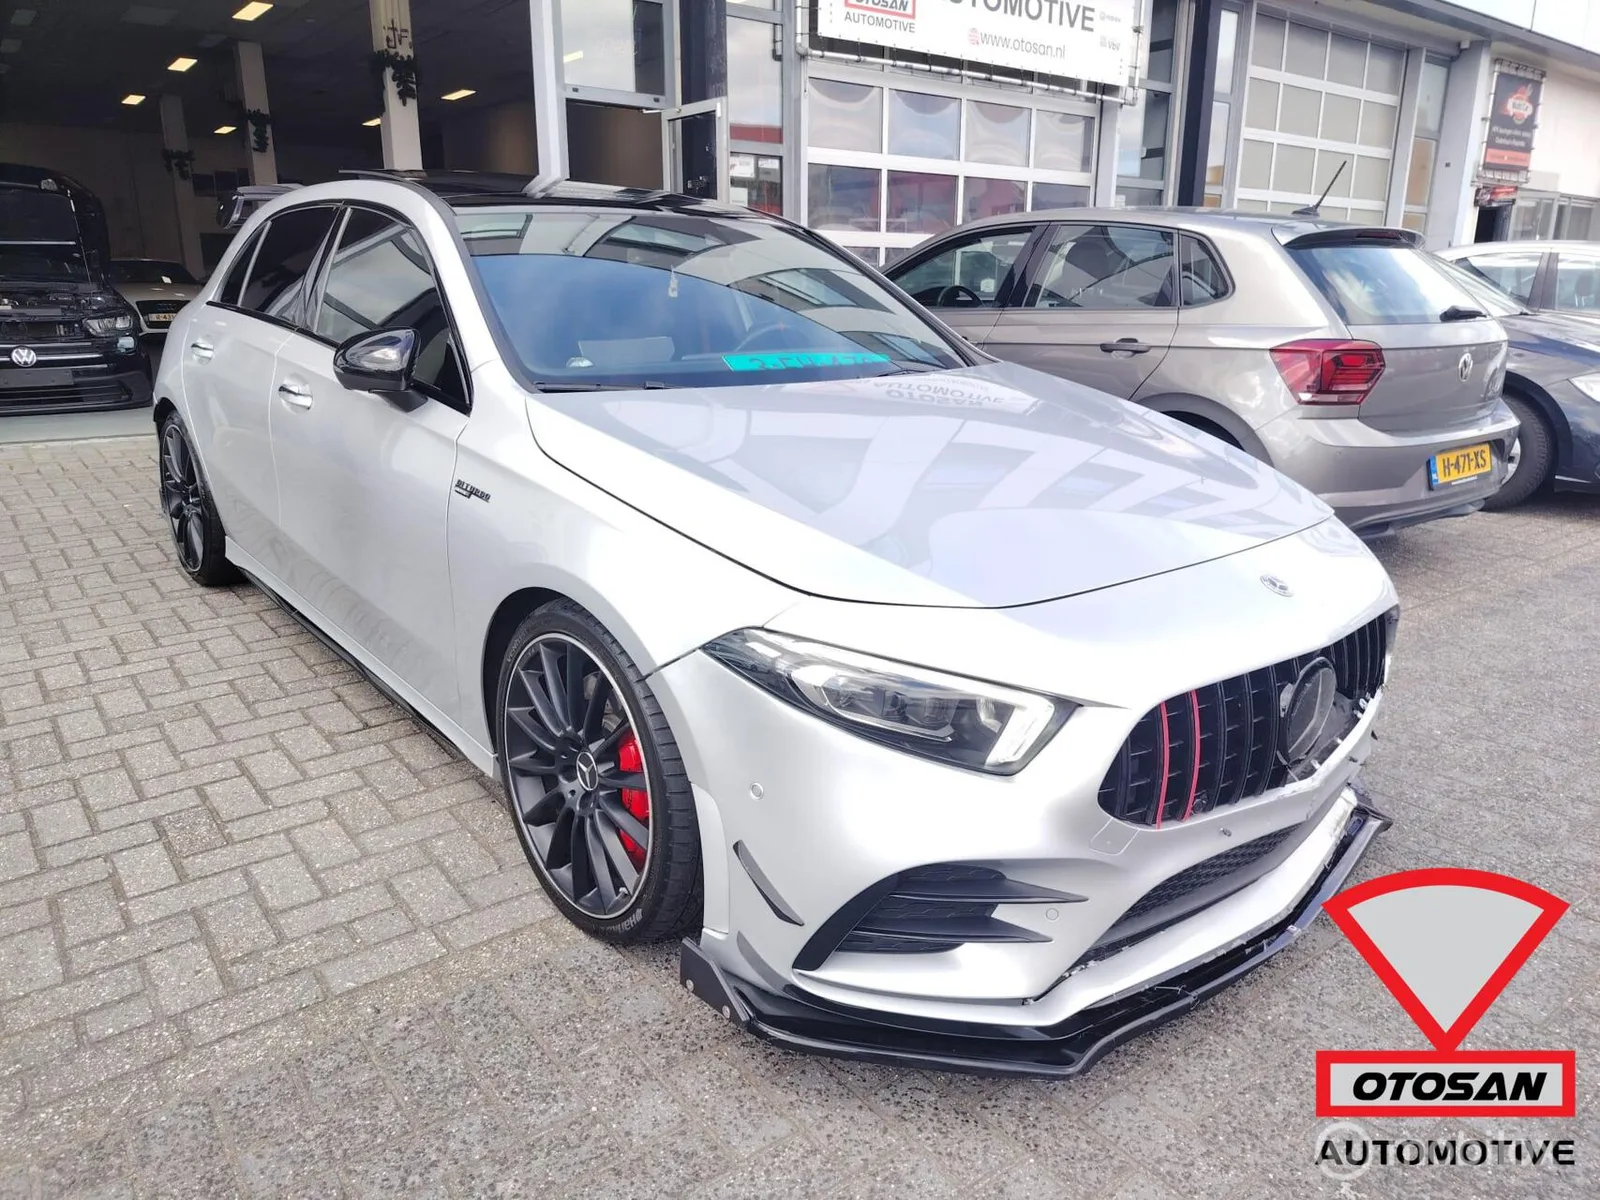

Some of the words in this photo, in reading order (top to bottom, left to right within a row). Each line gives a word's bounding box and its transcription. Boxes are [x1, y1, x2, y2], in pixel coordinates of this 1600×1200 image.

[844, 11, 916, 33] AUTOMOTIVE
[980, 31, 1066, 59] www.otosan.nl
[1442, 449, 1487, 478] H-471-XS
